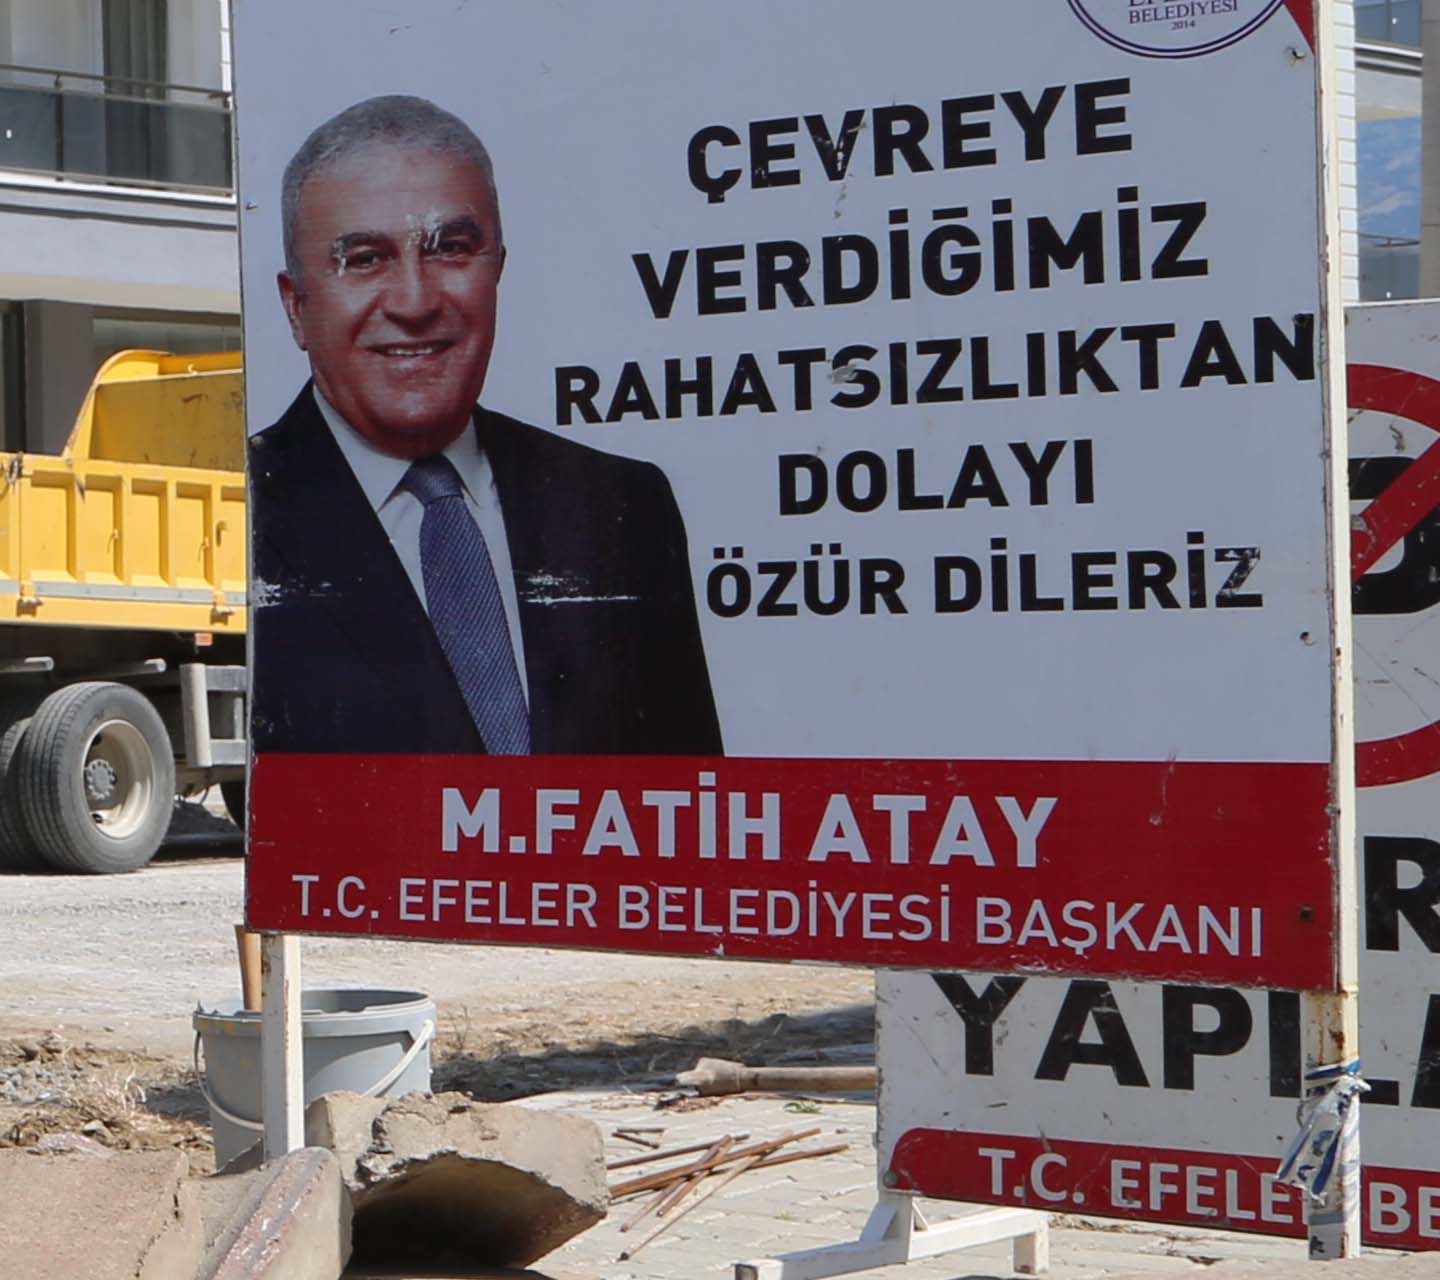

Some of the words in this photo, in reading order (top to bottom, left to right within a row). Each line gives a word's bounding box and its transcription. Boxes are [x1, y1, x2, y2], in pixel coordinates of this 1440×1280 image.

[1171, 20, 1196, 31] 2014
[687, 77, 1133, 204] ÇEVREYE
[632, 185, 1210, 320] VERDİĞİMİZ
[553, 312, 1317, 427] RAHATSIZLIKTAN
[777, 438, 1096, 516] DOLAYI
[706, 542, 910, 619] ÖZÜR
[933, 530, 1264, 614] DİLERİZ
[441, 770, 781, 862] M.FATİH
[807, 793, 1059, 869] ATAY
[291, 874, 380, 920] T.C.
[399, 877, 598, 929] EFELER
[617, 879, 951, 944] BELEDİYESİ
[975, 896, 1263, 958] BAŞKANI
[978, 1147, 1086, 1204] T.C.
[1110, 1158, 1309, 1226] EFELE
